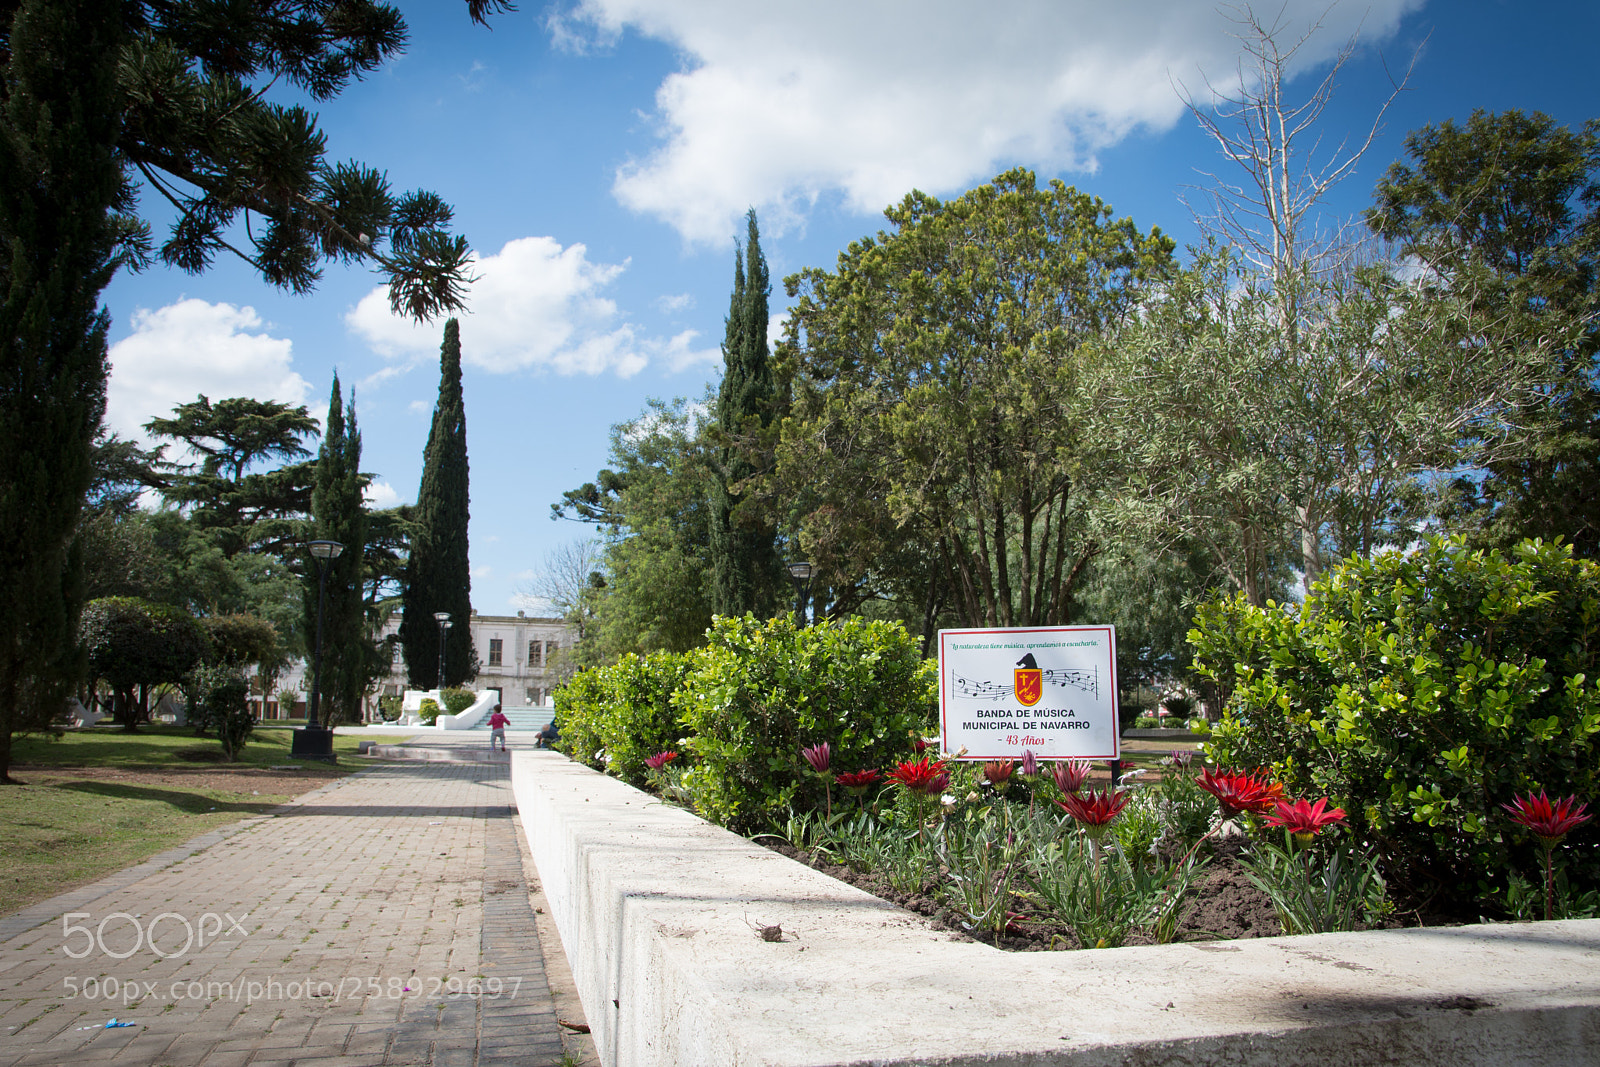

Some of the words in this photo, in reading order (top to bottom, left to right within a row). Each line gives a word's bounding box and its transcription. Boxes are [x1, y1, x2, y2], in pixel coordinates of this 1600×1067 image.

[1026, 641, 1061, 650] aprendamos
[977, 709, 1013, 718] BANDA
[1016, 709, 1031, 718] DE
[1034, 708, 1075, 718] MÚSICA
[962, 721, 1020, 730] MUNICIPAL
[1022, 721, 1037, 730] DE
[1040, 721, 1090, 730] NAVARRO
[1005, 734, 1019, 745] 43
[1020, 735, 1045, 746] Años
